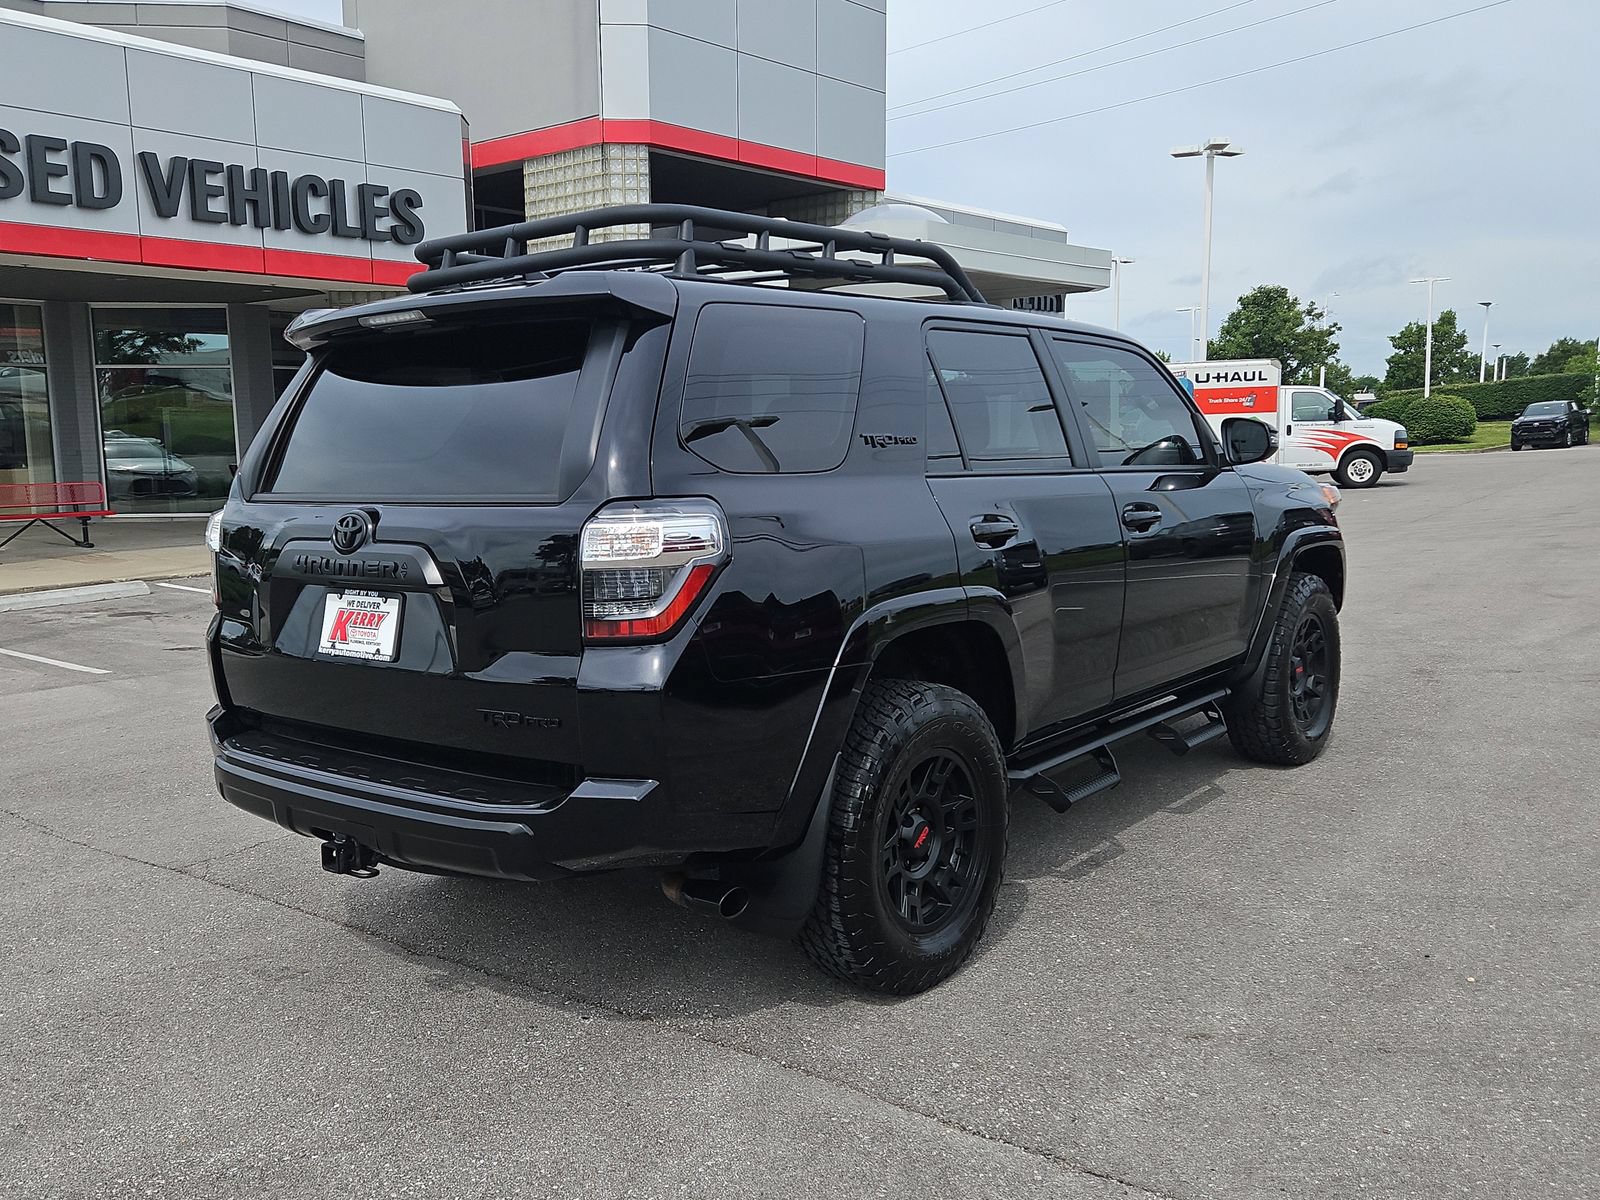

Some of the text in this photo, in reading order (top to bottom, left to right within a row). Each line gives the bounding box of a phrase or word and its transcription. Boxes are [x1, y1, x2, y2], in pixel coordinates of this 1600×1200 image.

[138, 151, 425, 245] VEHICLES
[1195, 370, 1268, 383] U-HAUL
[346, 600, 381, 610] WE DELIVER
[329, 609, 387, 643] KERRY
